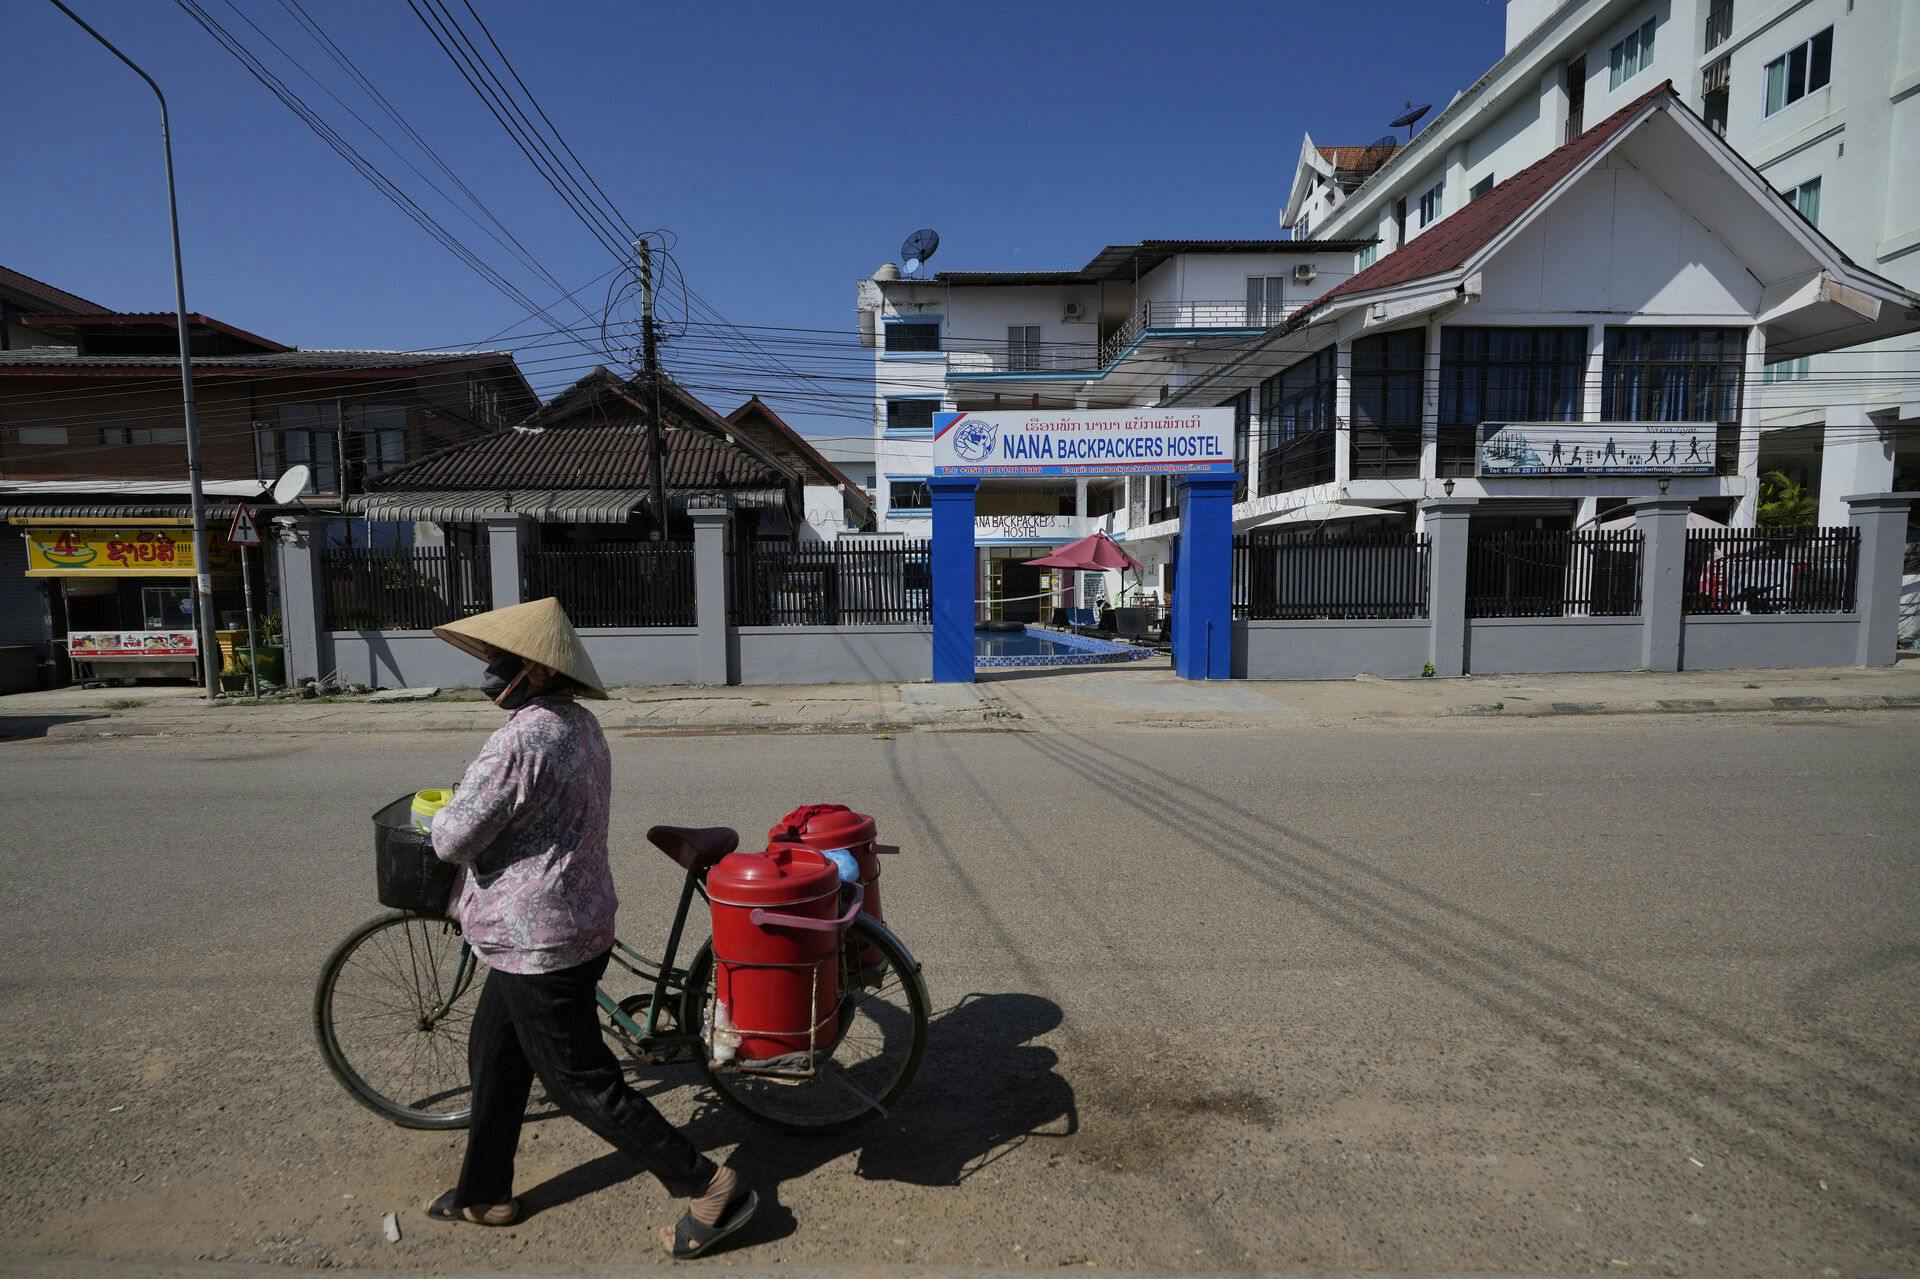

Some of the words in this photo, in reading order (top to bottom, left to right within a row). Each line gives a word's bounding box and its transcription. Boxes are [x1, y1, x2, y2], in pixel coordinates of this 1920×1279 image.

[1003, 434, 1053, 459] NANA
[1057, 437, 1163, 458] BACKPACKERS
[1167, 435, 1223, 456] HOSTEL
[960, 466, 981, 474] +856
[983, 466, 994, 474] 20
[997, 466, 1018, 474] 9196
[1003, 527, 1040, 538] HOSTEL
